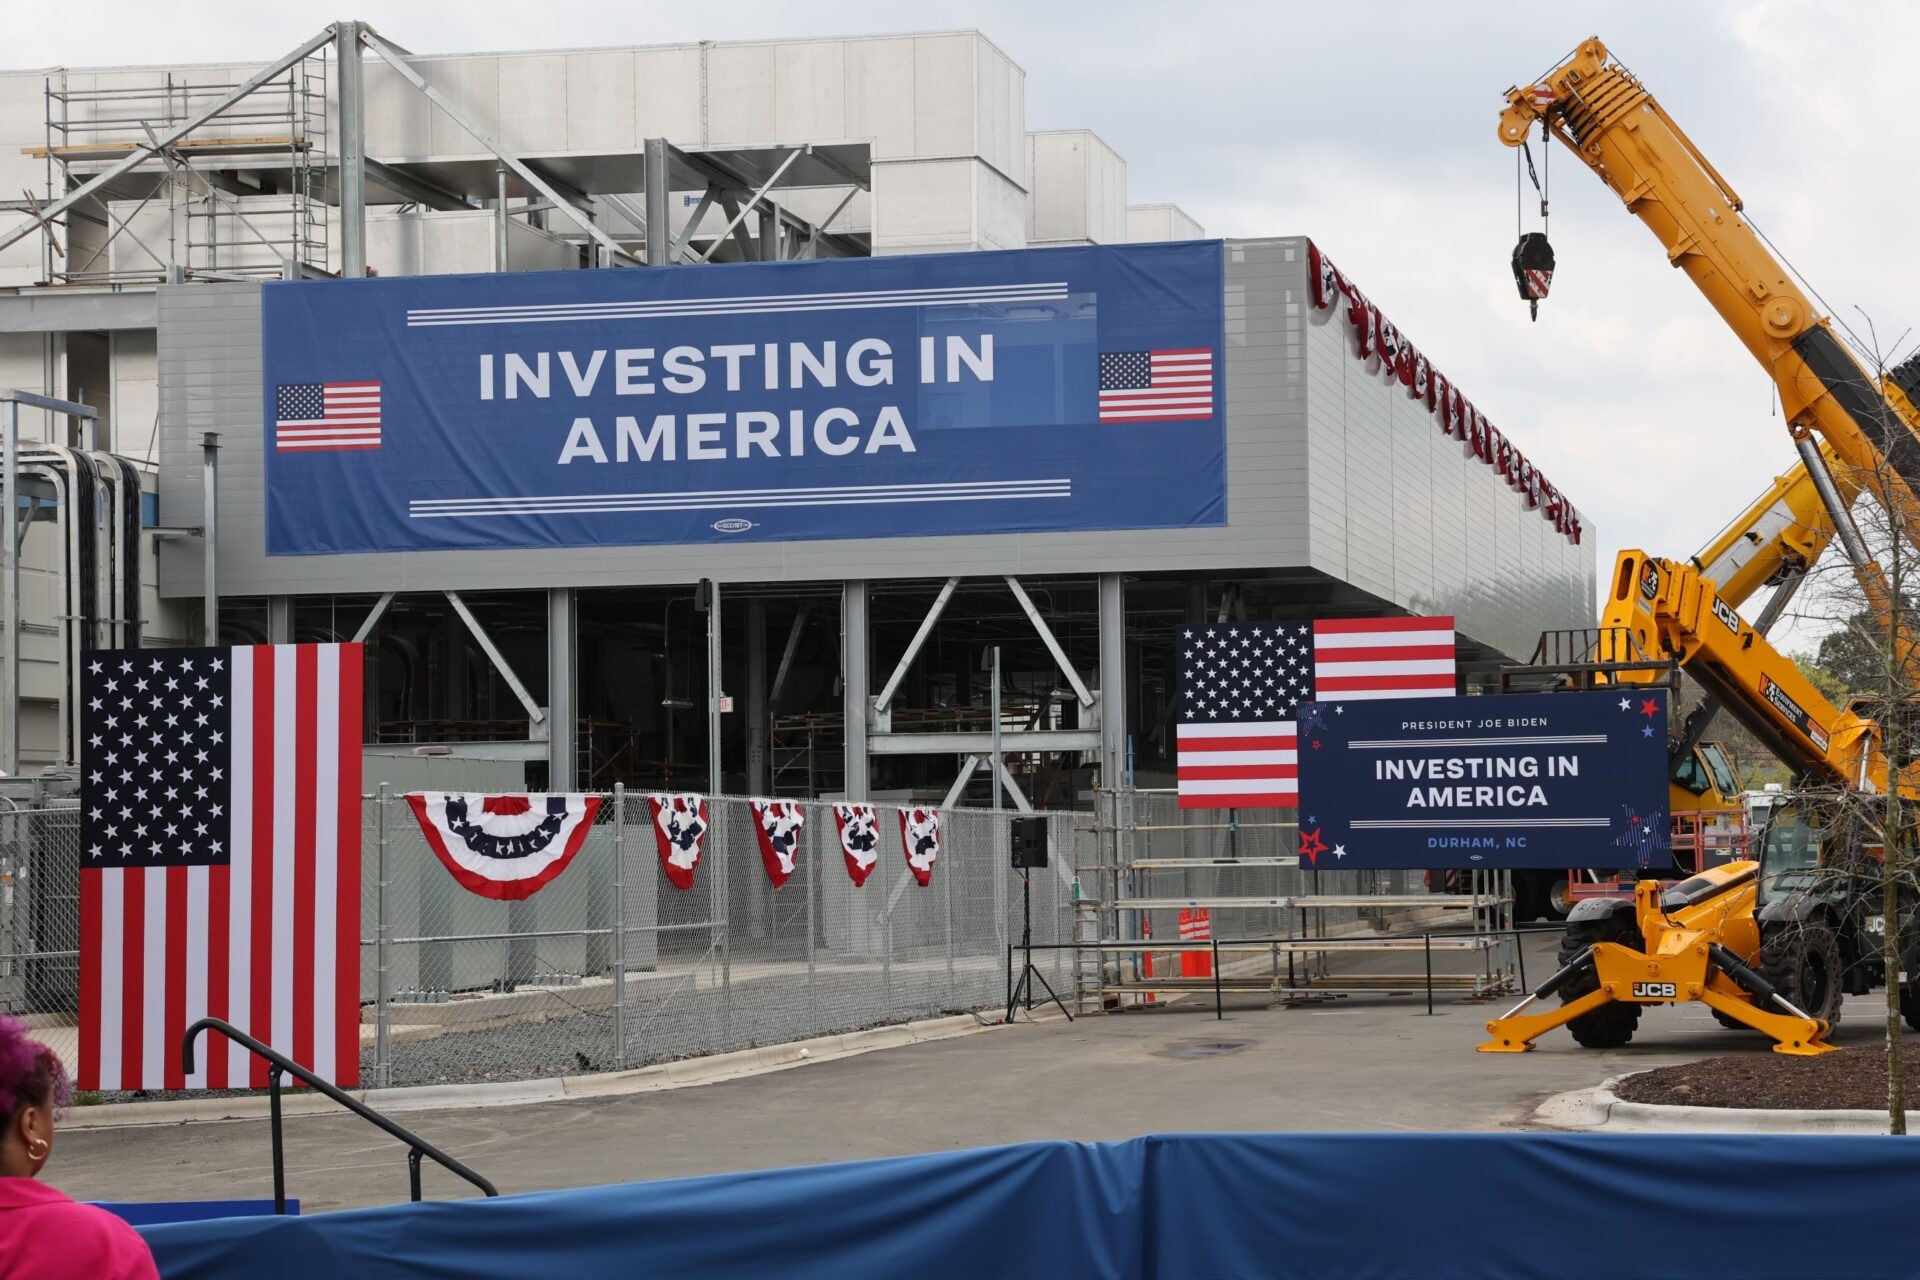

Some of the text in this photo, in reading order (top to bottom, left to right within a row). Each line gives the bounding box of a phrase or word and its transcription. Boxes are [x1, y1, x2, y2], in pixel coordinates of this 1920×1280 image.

[480, 334, 994, 400] INVESTING IN
[557, 406, 917, 465] AMERICA
[1712, 597, 1739, 633] JCB
[1402, 717, 1548, 730] PRESIDENT JOE BIDEN
[1376, 755, 1579, 780] INVESTING IN
[1406, 785, 1549, 808] AMERICA
[1428, 836, 1527, 849] DURHAM, NC
[1869, 917, 1884, 933] JC
[1634, 983, 1676, 997] JCB
